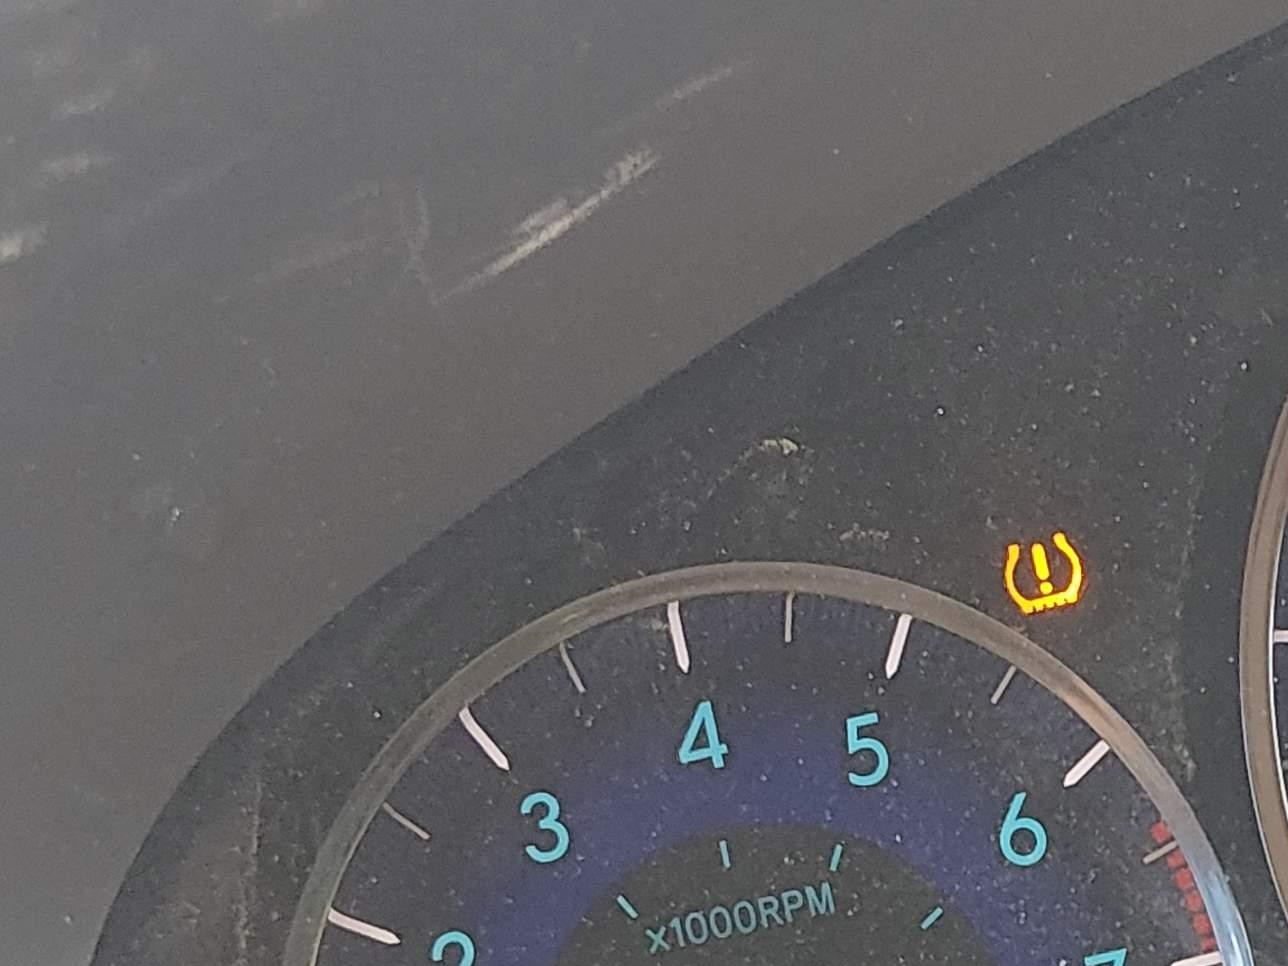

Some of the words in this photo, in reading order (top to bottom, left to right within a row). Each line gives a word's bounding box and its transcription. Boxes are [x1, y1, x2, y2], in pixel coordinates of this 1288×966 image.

[680, 703, 726, 767] 4
[847, 714, 888, 785] 5
[521, 793, 568, 862] 3
[1000, 794, 1046, 865] 6
[645, 881, 835, 954] x1000RPM
